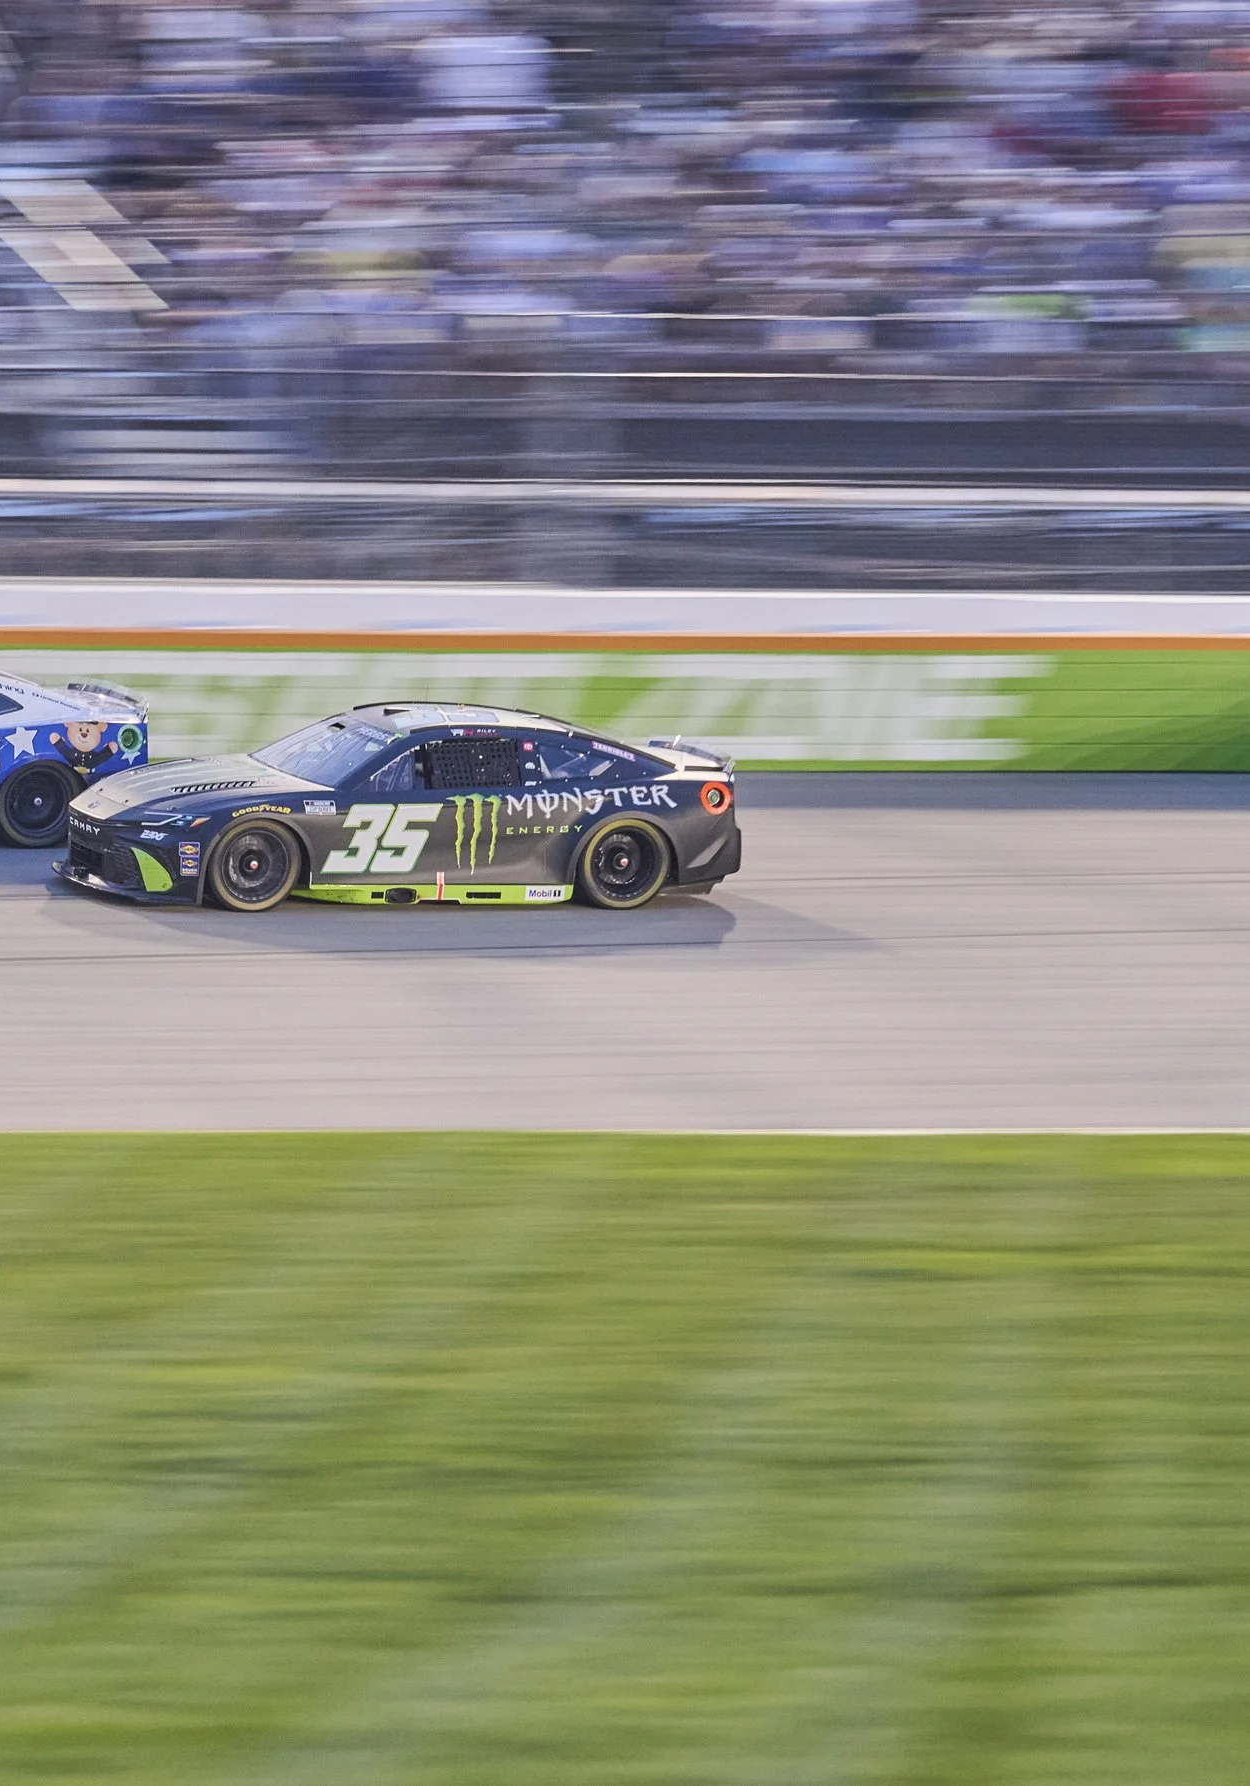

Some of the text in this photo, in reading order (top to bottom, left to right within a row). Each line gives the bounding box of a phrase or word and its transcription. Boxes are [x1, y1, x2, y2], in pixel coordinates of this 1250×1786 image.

[505, 784, 678, 820] MONSTER
[232, 804, 291, 818] GOODYEAR
[69, 816, 101, 836] CAMRY
[506, 825, 584, 835] ENERGY
[320, 803, 444, 874] 35
[528, 889, 552, 897] Mobil
